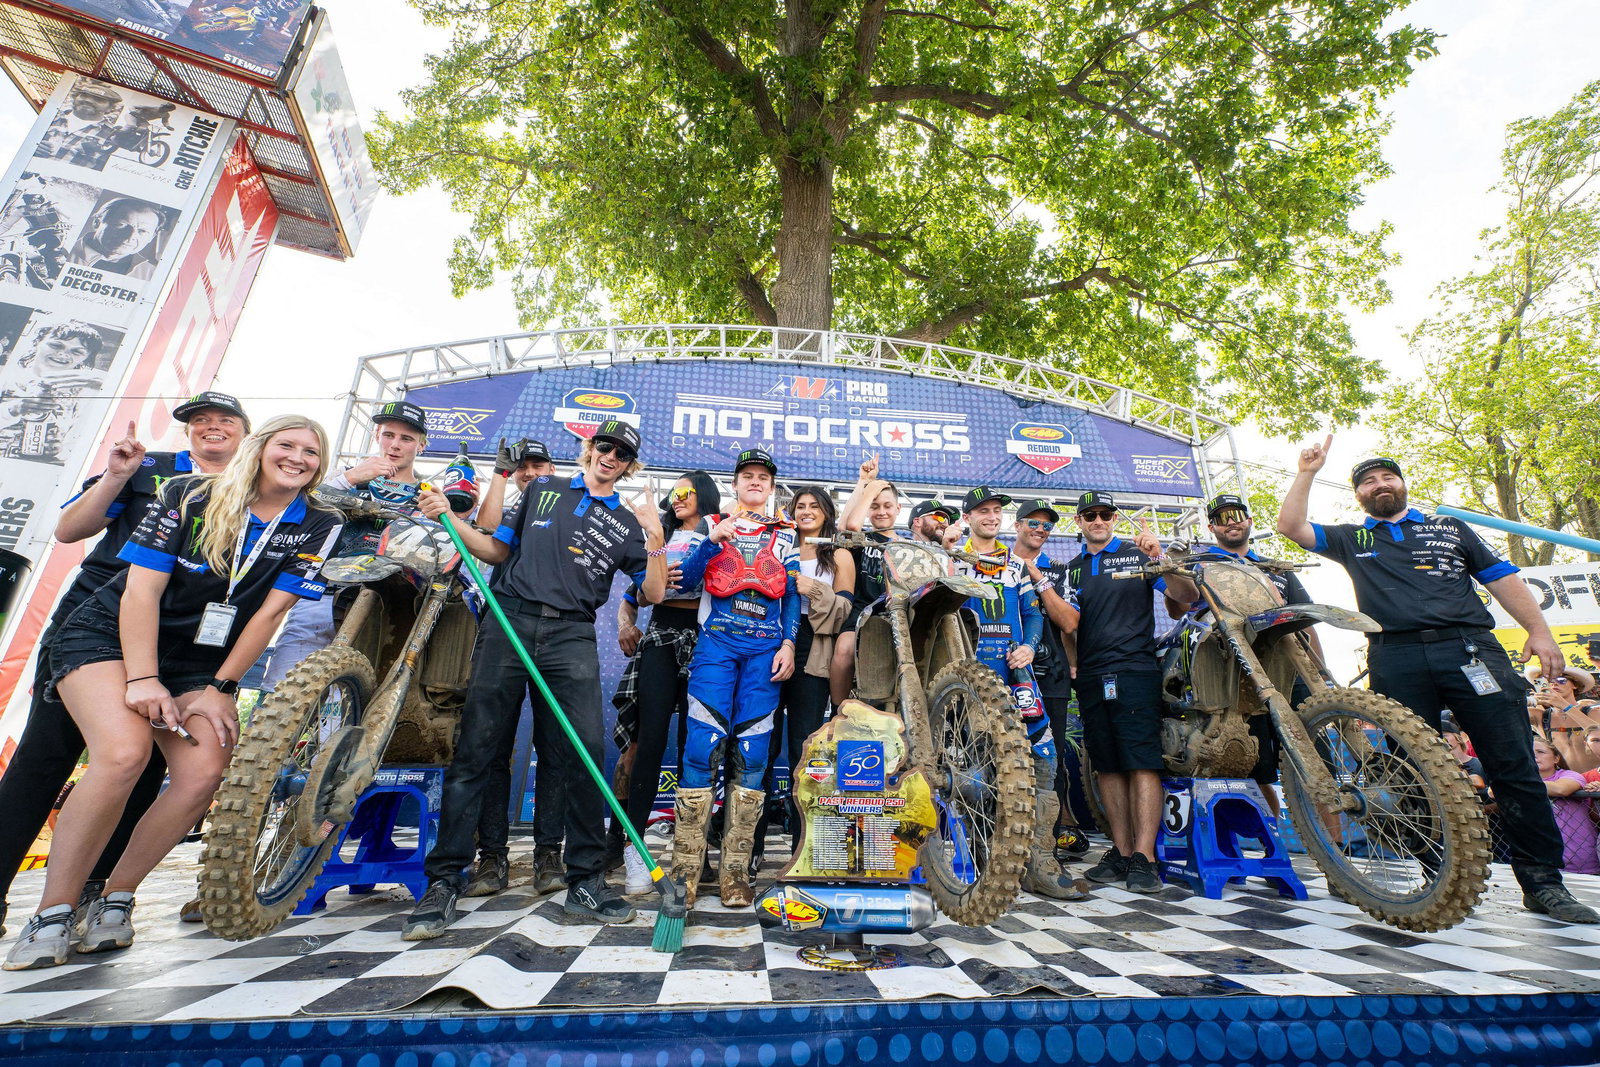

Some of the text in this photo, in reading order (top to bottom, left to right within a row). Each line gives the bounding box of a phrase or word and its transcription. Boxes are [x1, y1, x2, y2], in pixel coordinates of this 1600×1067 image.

[115, 17, 169, 40] BARNETT
[223, 53, 277, 77] STEWART
[173, 115, 219, 190] GENE RITCHIE
[67, 266, 103, 281] ROGER
[61, 276, 138, 302] DECOSTER
[762, 374, 889, 401] AMA PRO
[846, 395, 889, 404] RACING
[578, 412, 617, 422] REDBUD
[788, 402, 862, 417] PRO
[672, 406, 971, 452] MOTOCROSS
[31, 424, 42, 453] SCOTT
[672, 436, 972, 464] CHAMPIONSHIP
[1027, 443, 1061, 454] REDBUD
[602, 511, 630, 536] YAMAHA
[1422, 524, 1459, 532] YAMAHA
[586, 527, 613, 549] THOR
[1425, 541, 1456, 550] THOR
[1111, 555, 1139, 564] YAMAHA
[735, 600, 766, 616] YAMALUBE
[980, 624, 1011, 634] YAMALUBE
[844, 755, 880, 778] 50
[1207, 782, 1247, 790] MOTOCROSS
[819, 797, 905, 807] PAST REDBUD 250
[839, 805, 882, 814] WINNERS
[1165, 794, 1183, 832] 3
[866, 914, 904, 923] MOTOCROSS
